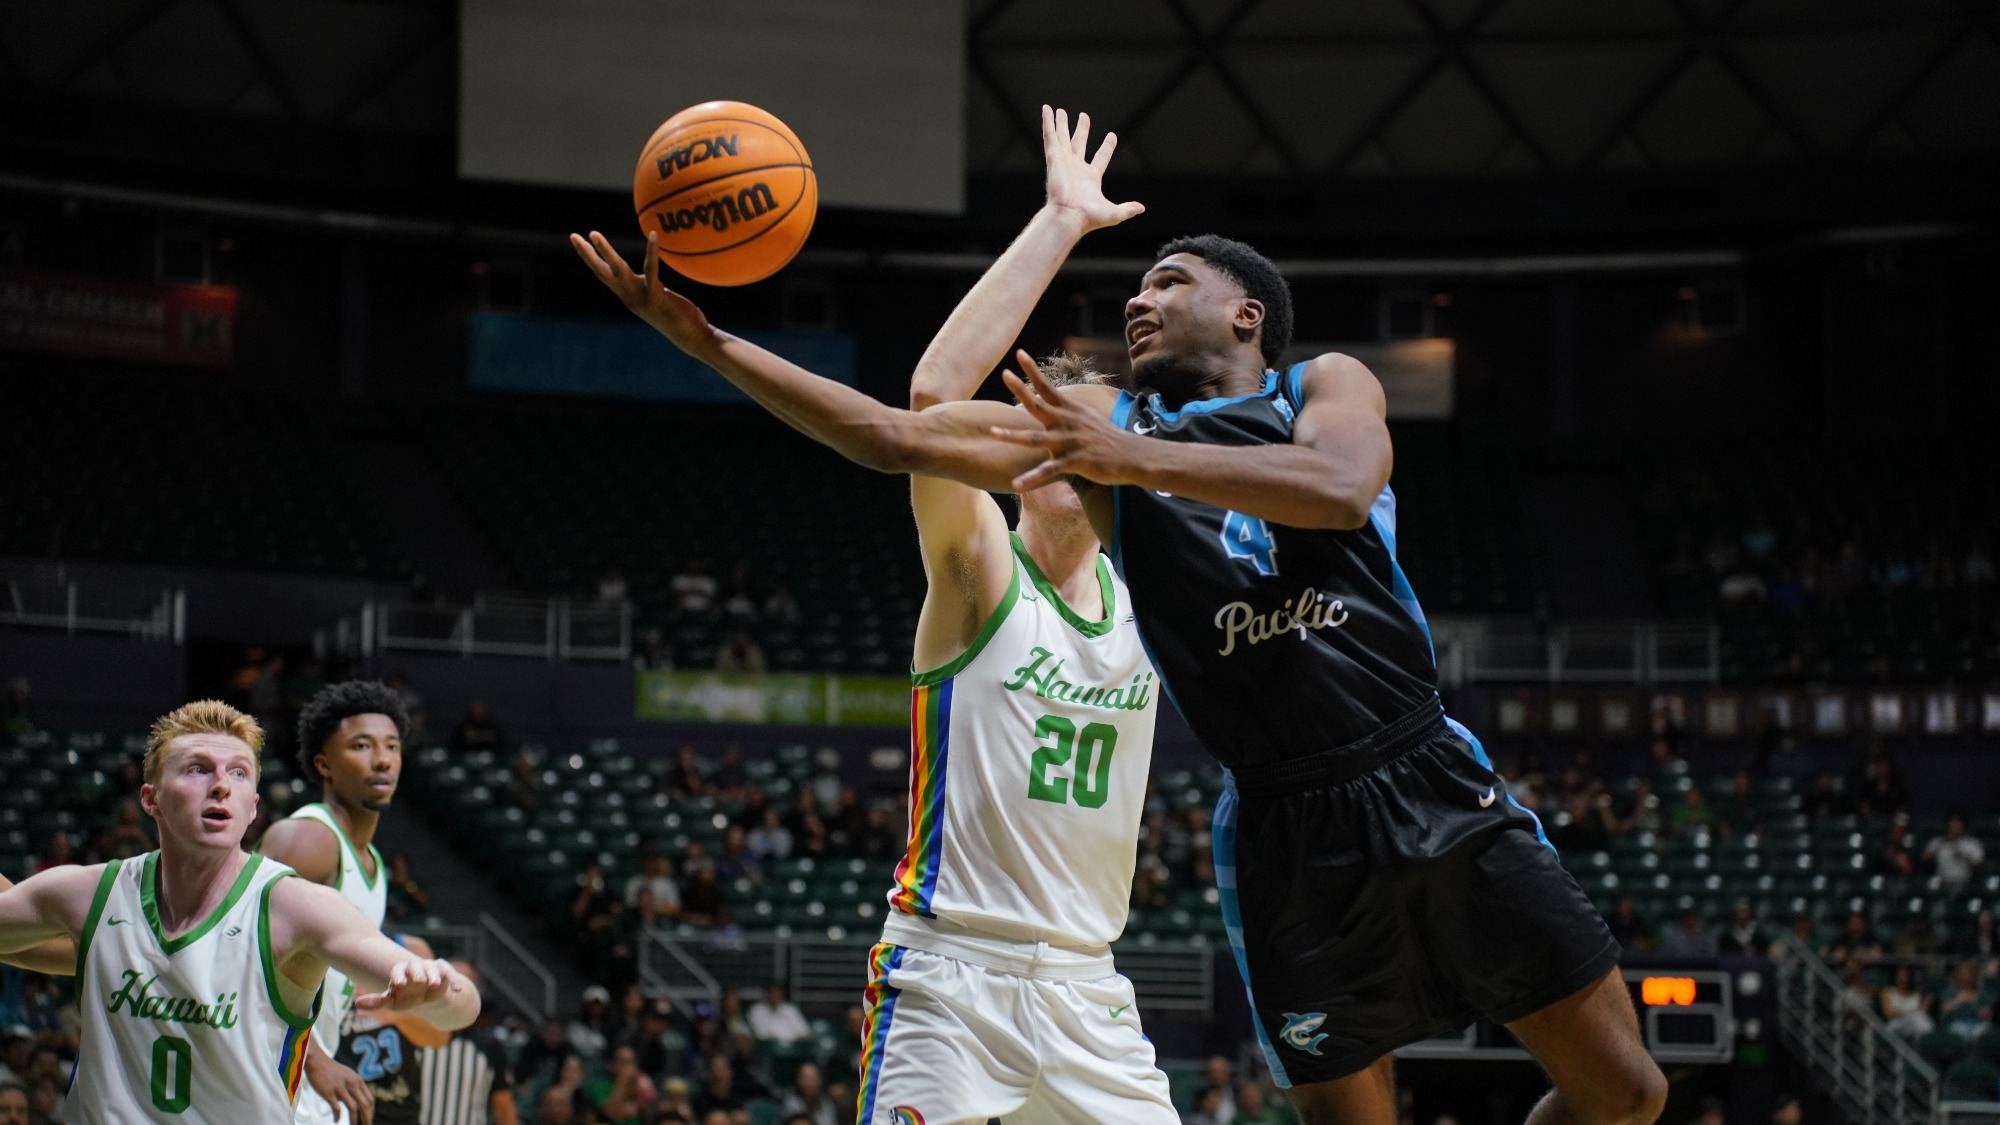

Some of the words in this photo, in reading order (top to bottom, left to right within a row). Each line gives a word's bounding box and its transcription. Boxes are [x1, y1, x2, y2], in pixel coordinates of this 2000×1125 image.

[657, 134, 739, 181] NCAA
[657, 183, 779, 233] Wilson
[1219, 509, 1281, 577] 4
[1214, 587, 1349, 657] Pacific
[1003, 646, 1153, 711] Hawaii
[1027, 714, 1118, 809] 20
[107, 969, 238, 1029] Hawaii
[151, 1035, 191, 1114] 0
[351, 1027, 403, 1082] 23
